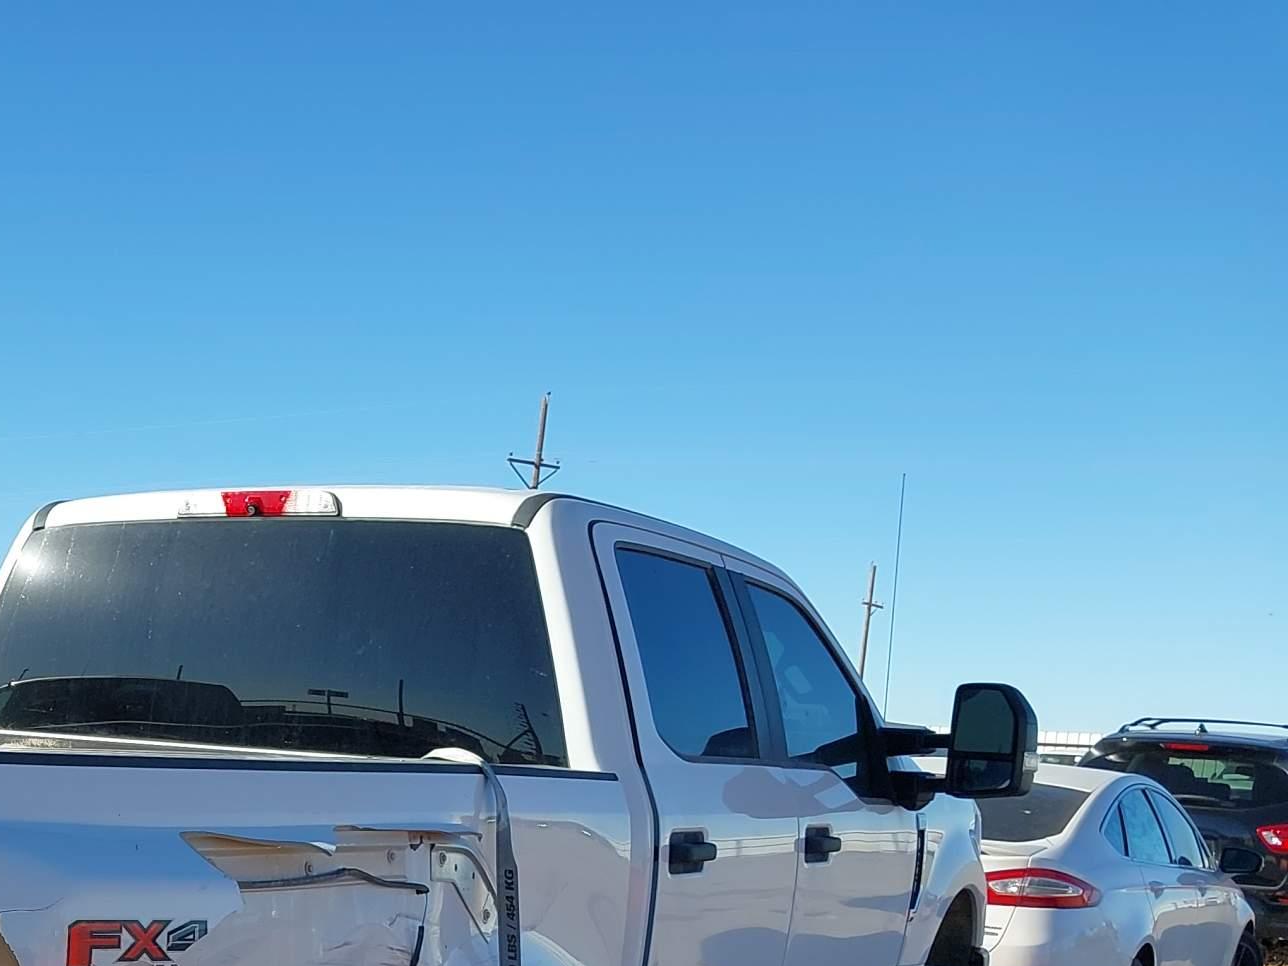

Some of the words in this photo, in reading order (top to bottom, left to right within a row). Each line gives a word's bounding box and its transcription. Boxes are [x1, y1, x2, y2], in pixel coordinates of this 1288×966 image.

[504, 869, 515, 891] KG
[505, 895, 516, 921] 454
[507, 933, 518, 961] LBS
